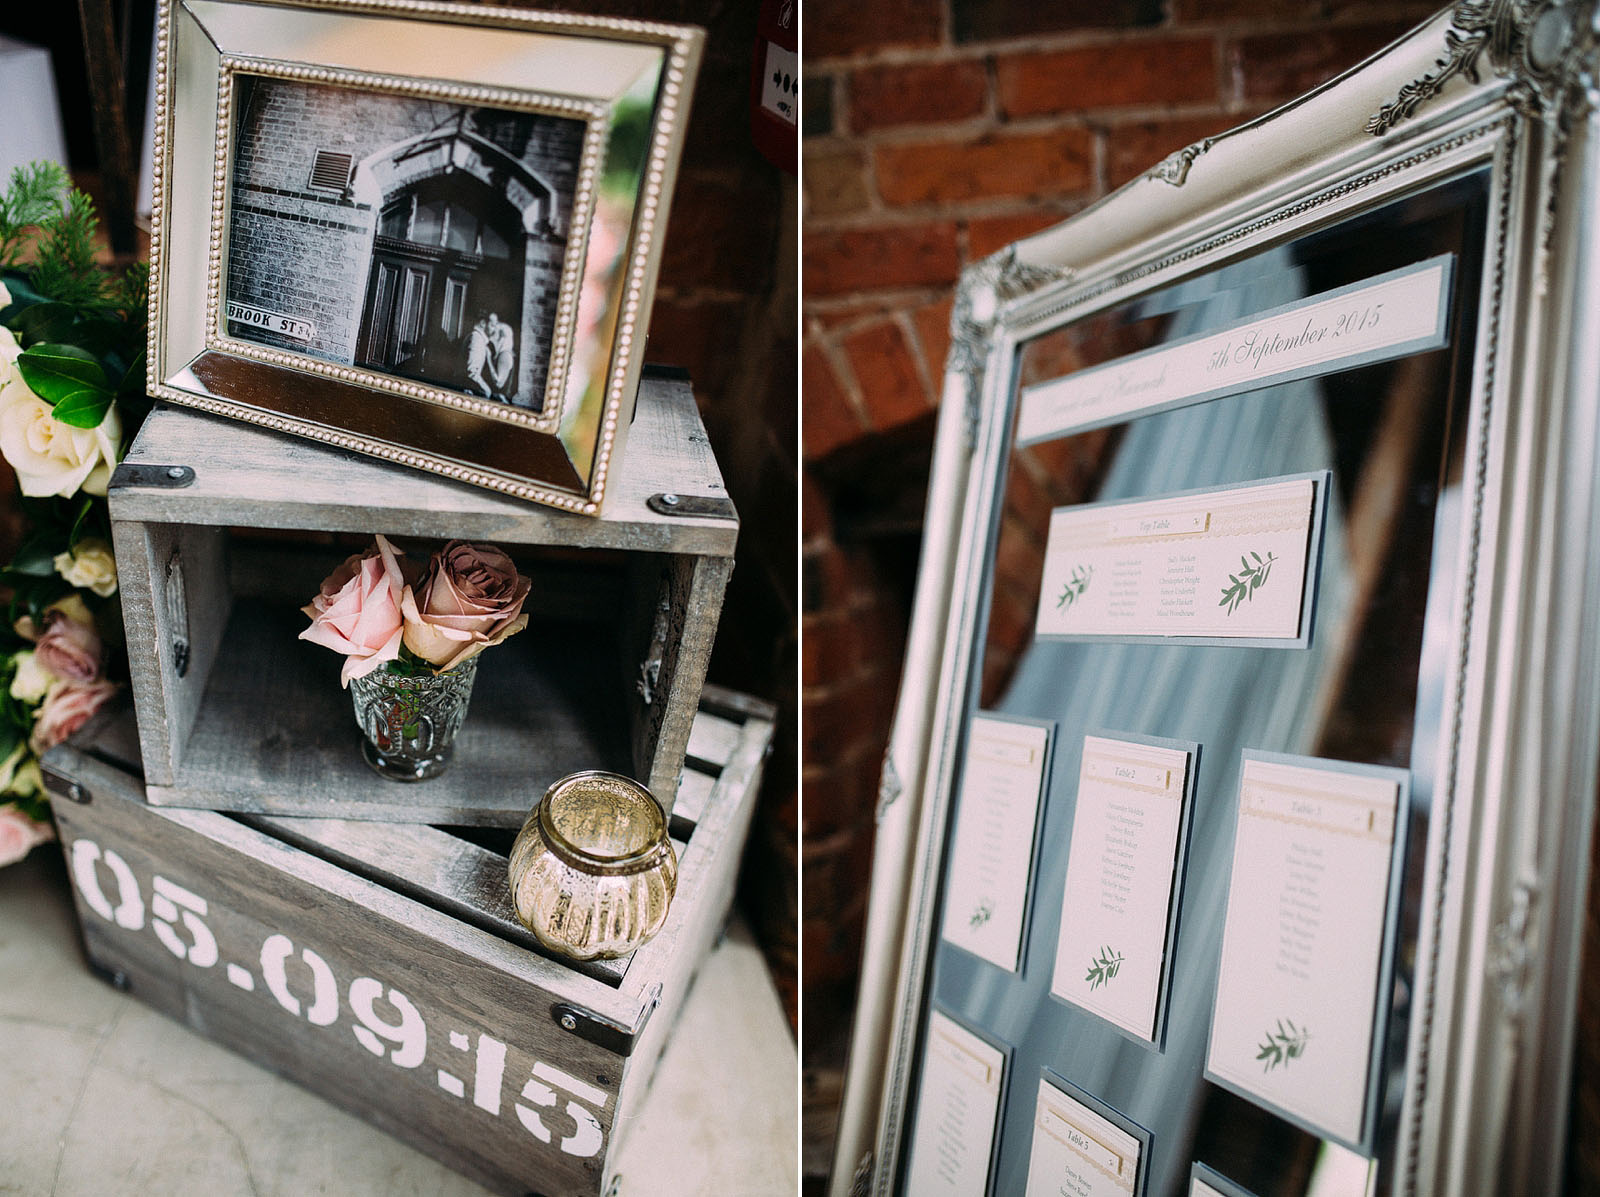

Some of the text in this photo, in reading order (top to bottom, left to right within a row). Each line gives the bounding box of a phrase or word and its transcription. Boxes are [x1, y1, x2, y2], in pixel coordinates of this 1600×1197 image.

[228, 305, 272, 327] BROOK
[1207, 341, 1232, 371] 5th
[1234, 317, 1328, 370] September
[1332, 303, 1385, 338] 2015
[1115, 767, 1131, 778] Table
[1067, 1129, 1084, 1147] Table
